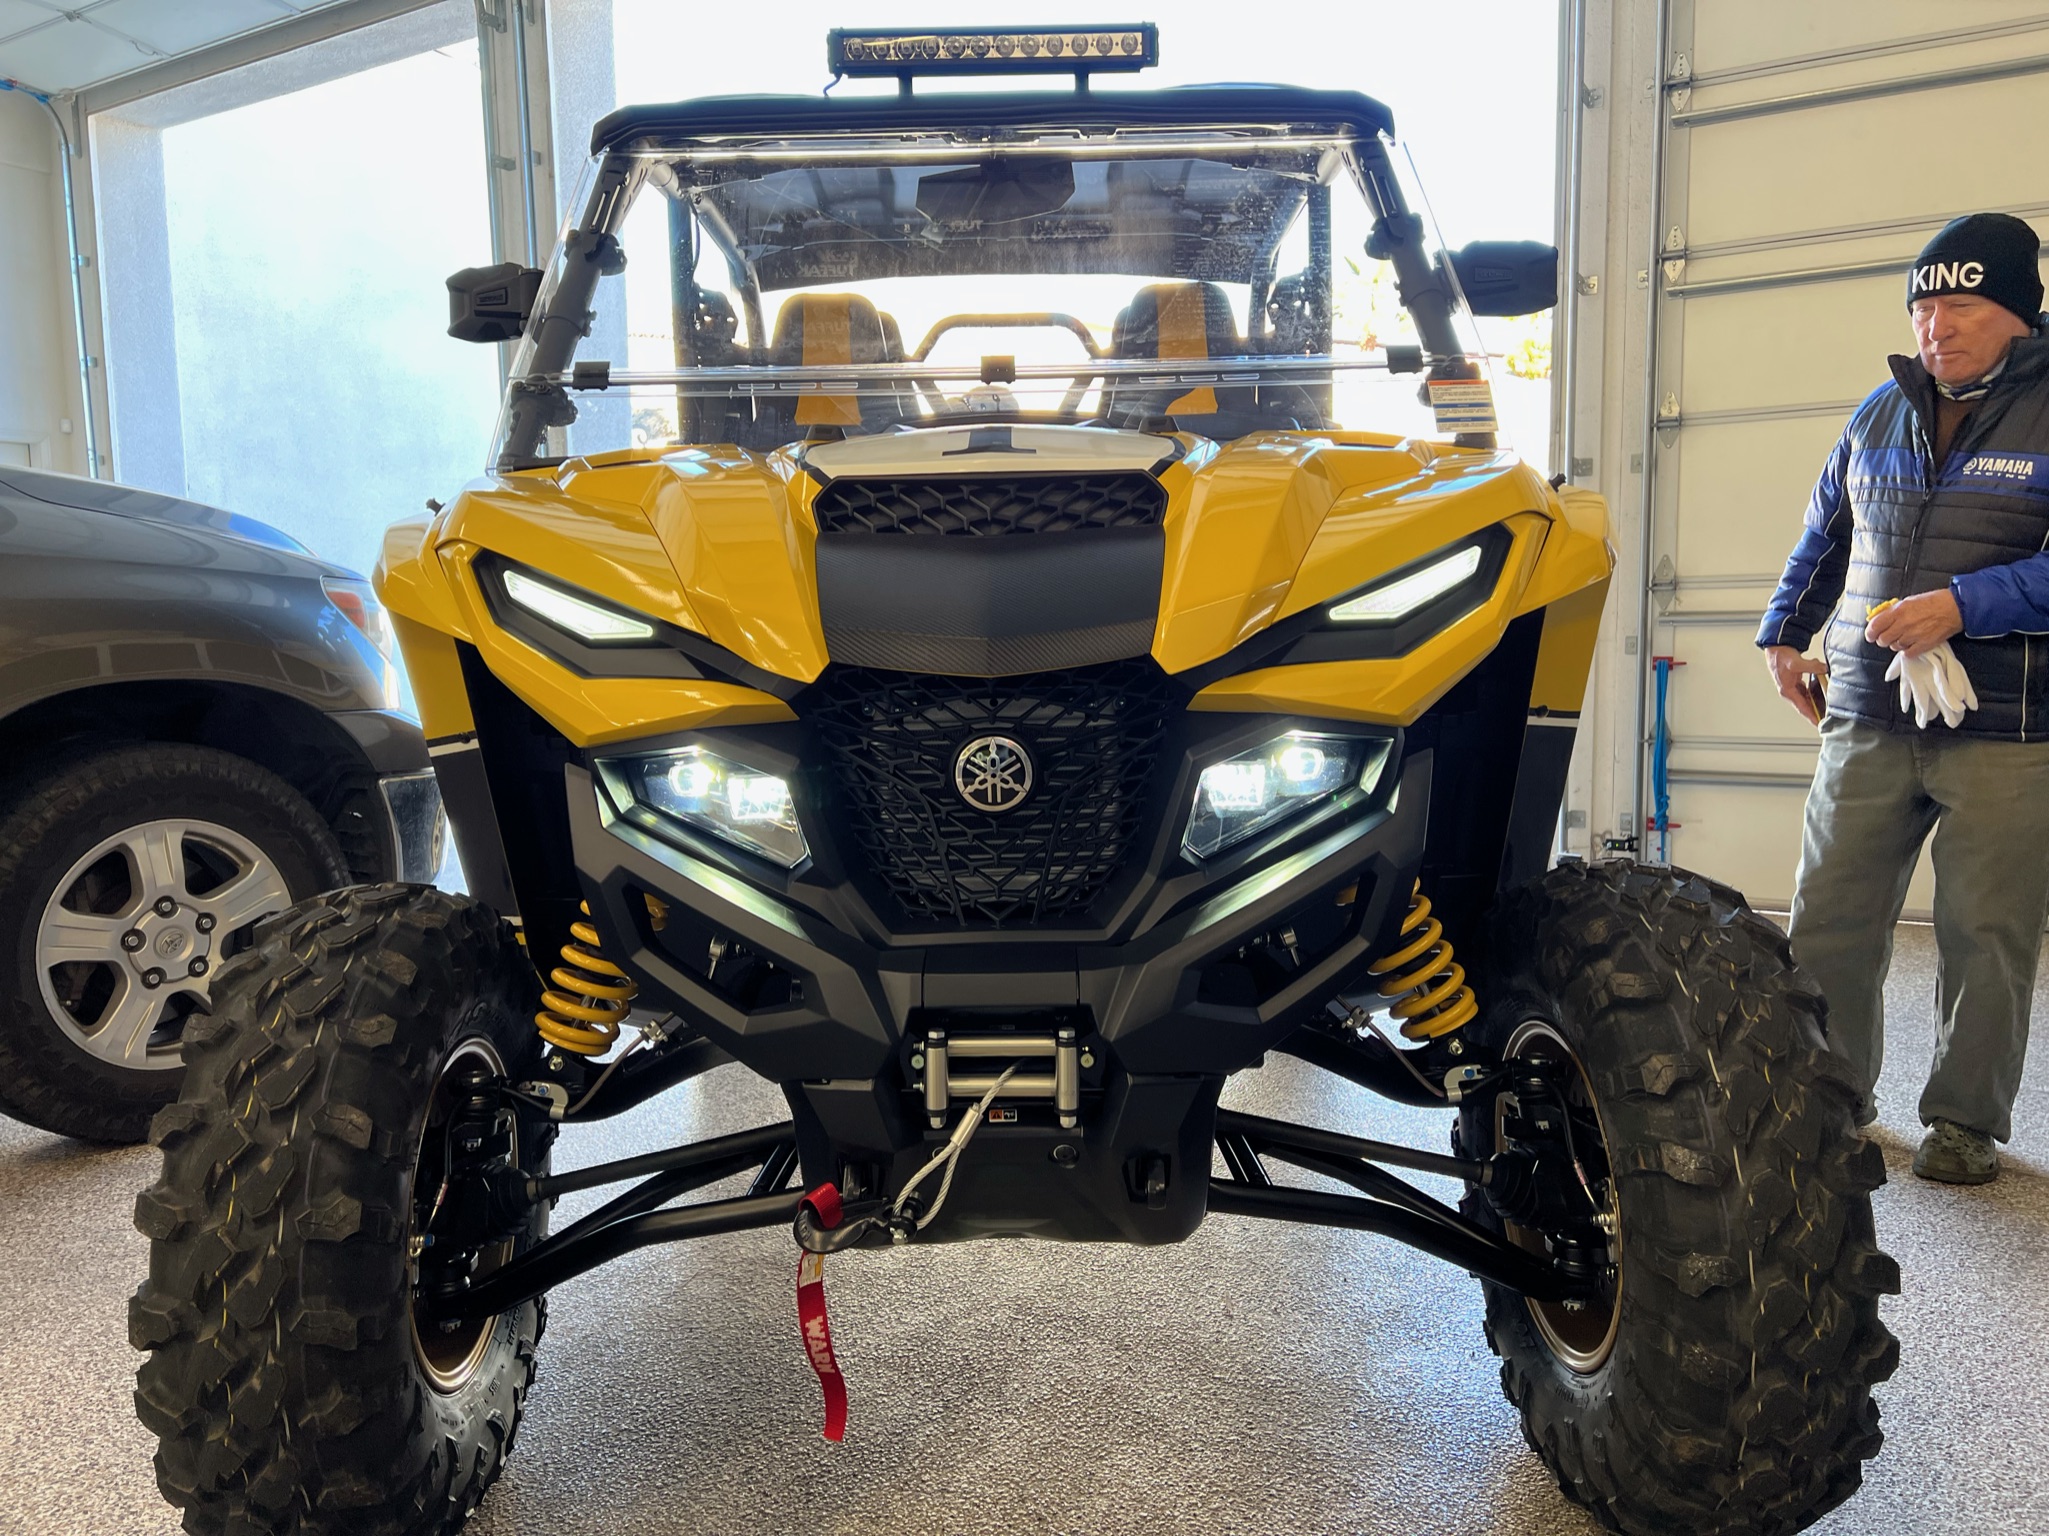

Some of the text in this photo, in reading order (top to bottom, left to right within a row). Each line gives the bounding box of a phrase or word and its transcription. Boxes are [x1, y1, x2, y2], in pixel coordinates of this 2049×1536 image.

[1912, 262, 1984, 293] KING
[1978, 458, 2034, 475] YAMAHA
[805, 1315, 836, 1374] WARN
